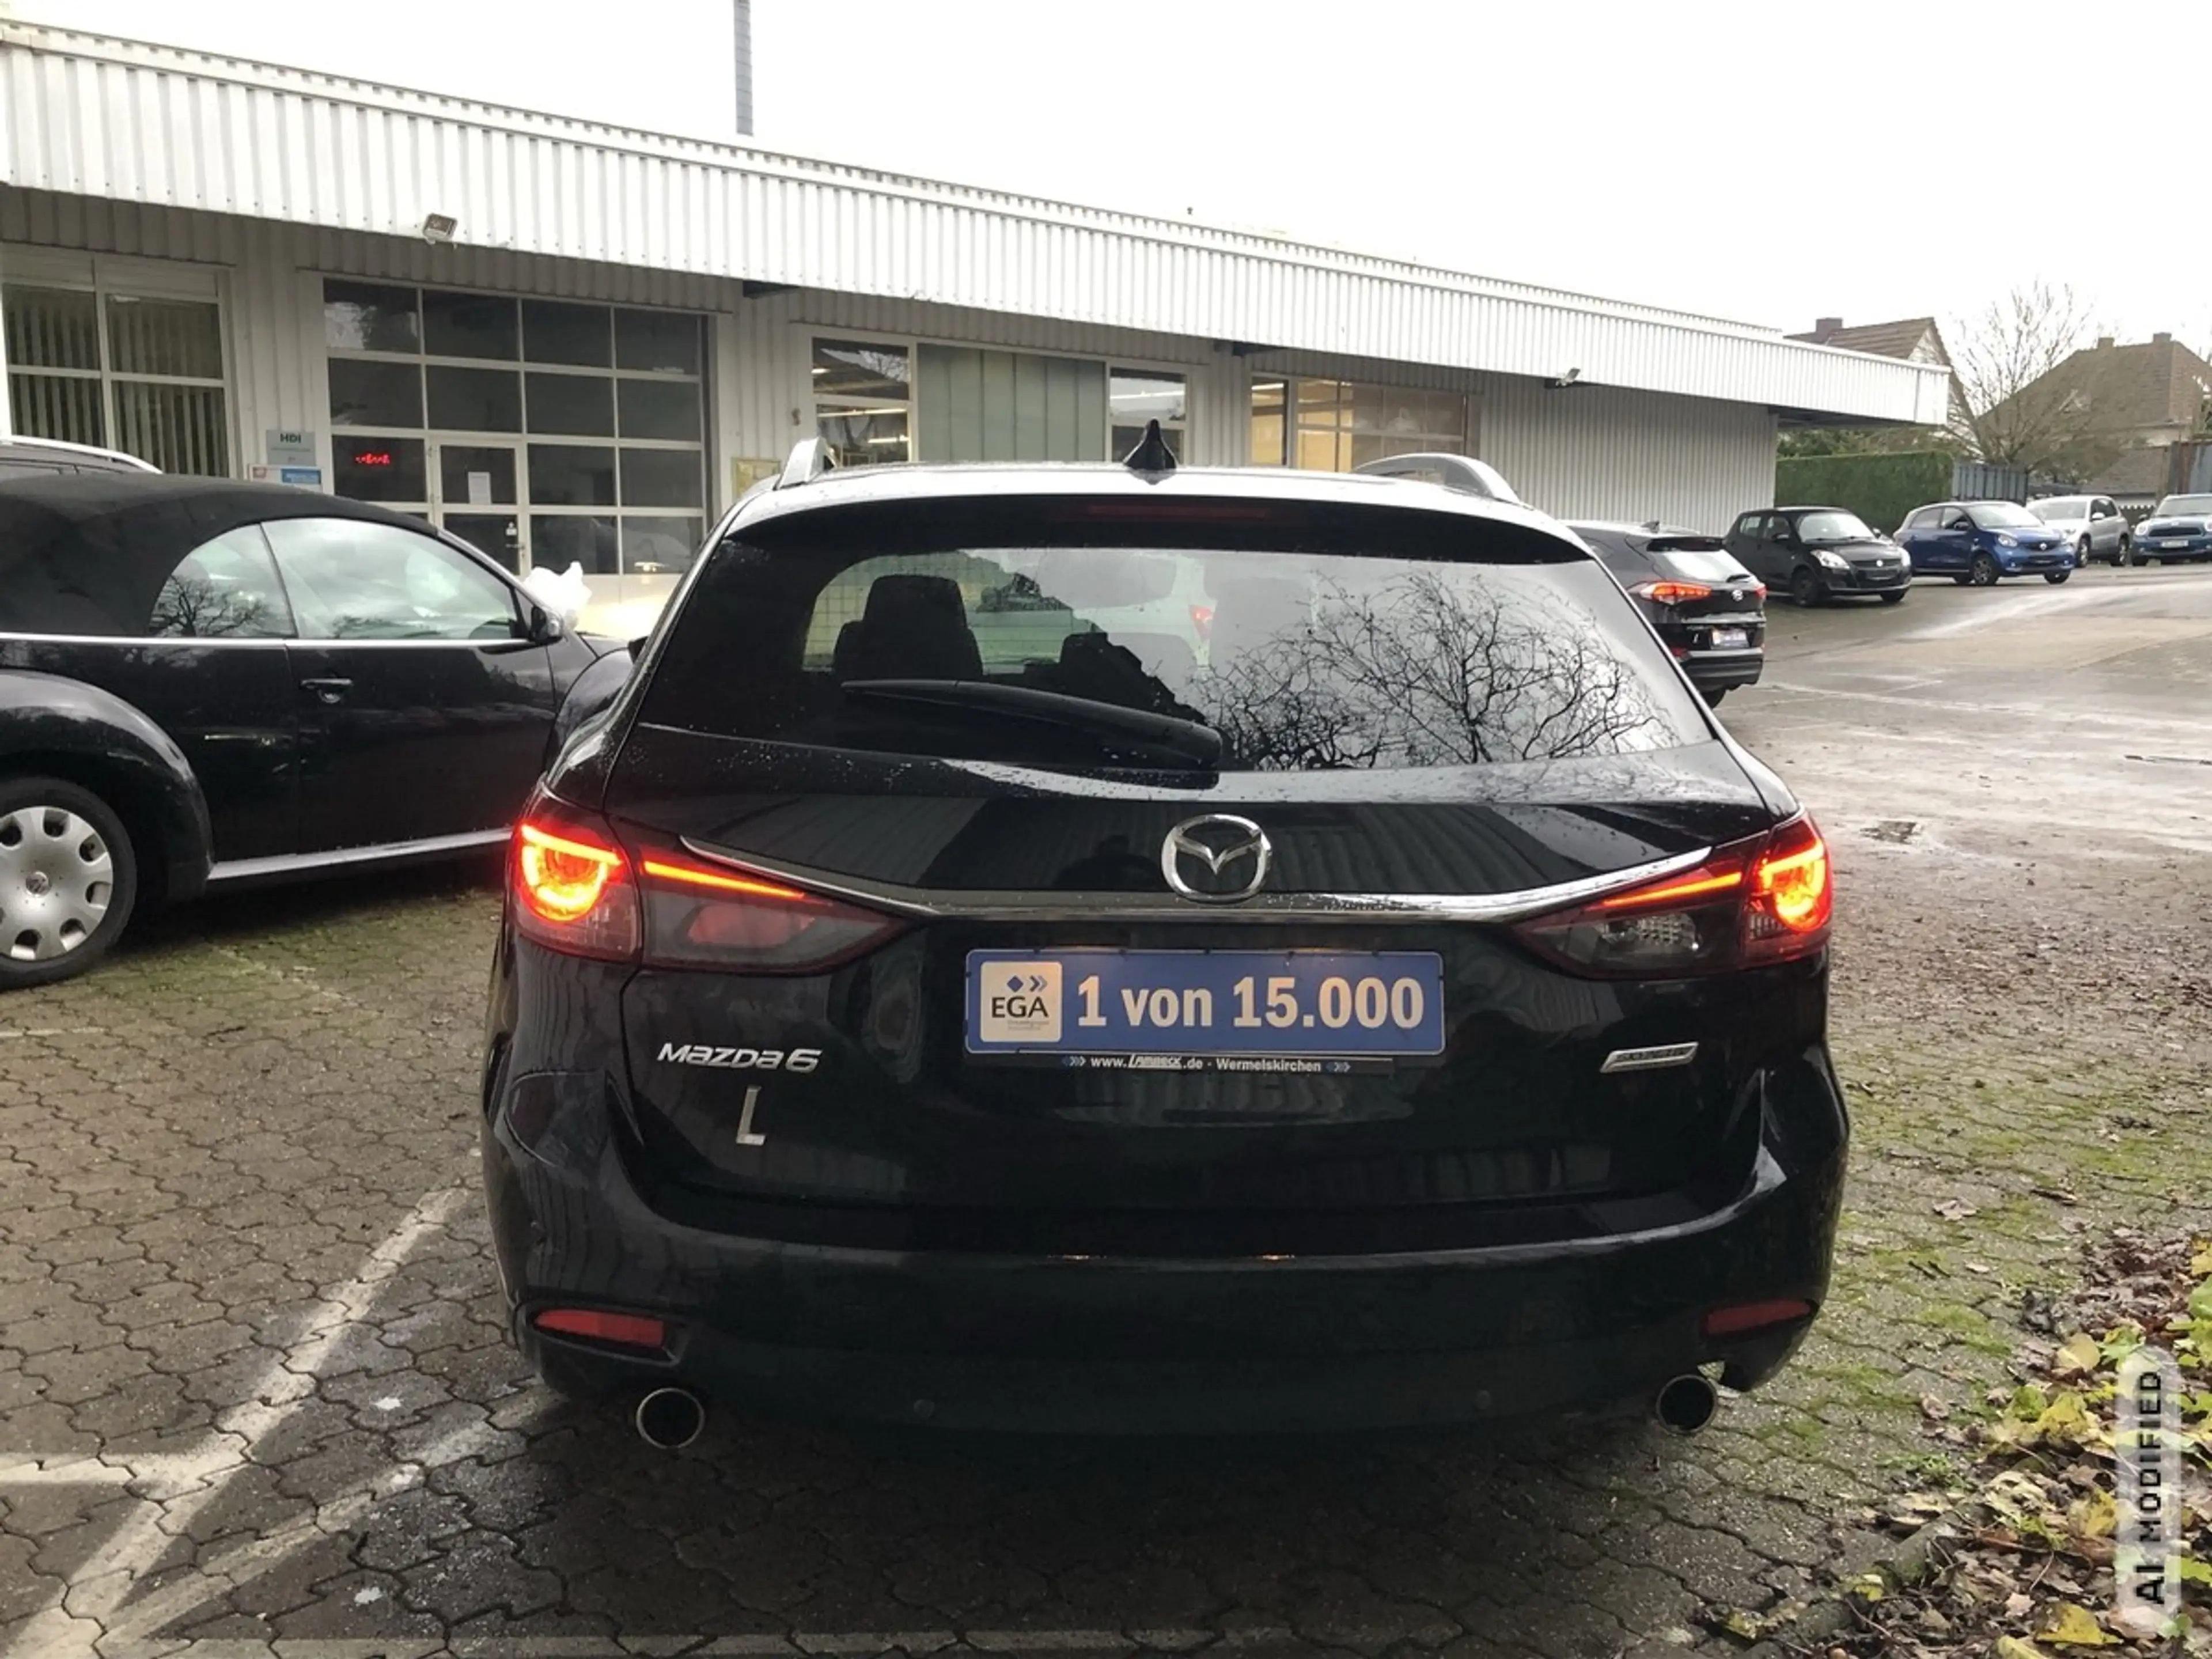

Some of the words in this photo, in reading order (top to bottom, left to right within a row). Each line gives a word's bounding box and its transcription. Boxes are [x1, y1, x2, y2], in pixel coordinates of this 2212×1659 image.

[279, 433, 301, 444] HDI
[992, 996, 1049, 1018] EGA
[1078, 975, 1107, 1027] 1
[1122, 987, 1213, 1027] von
[1233, 976, 1425, 1029] 15.000
[1216, 1057, 1321, 1072] Wermelskirchen
[736, 1085, 766, 1146] L
